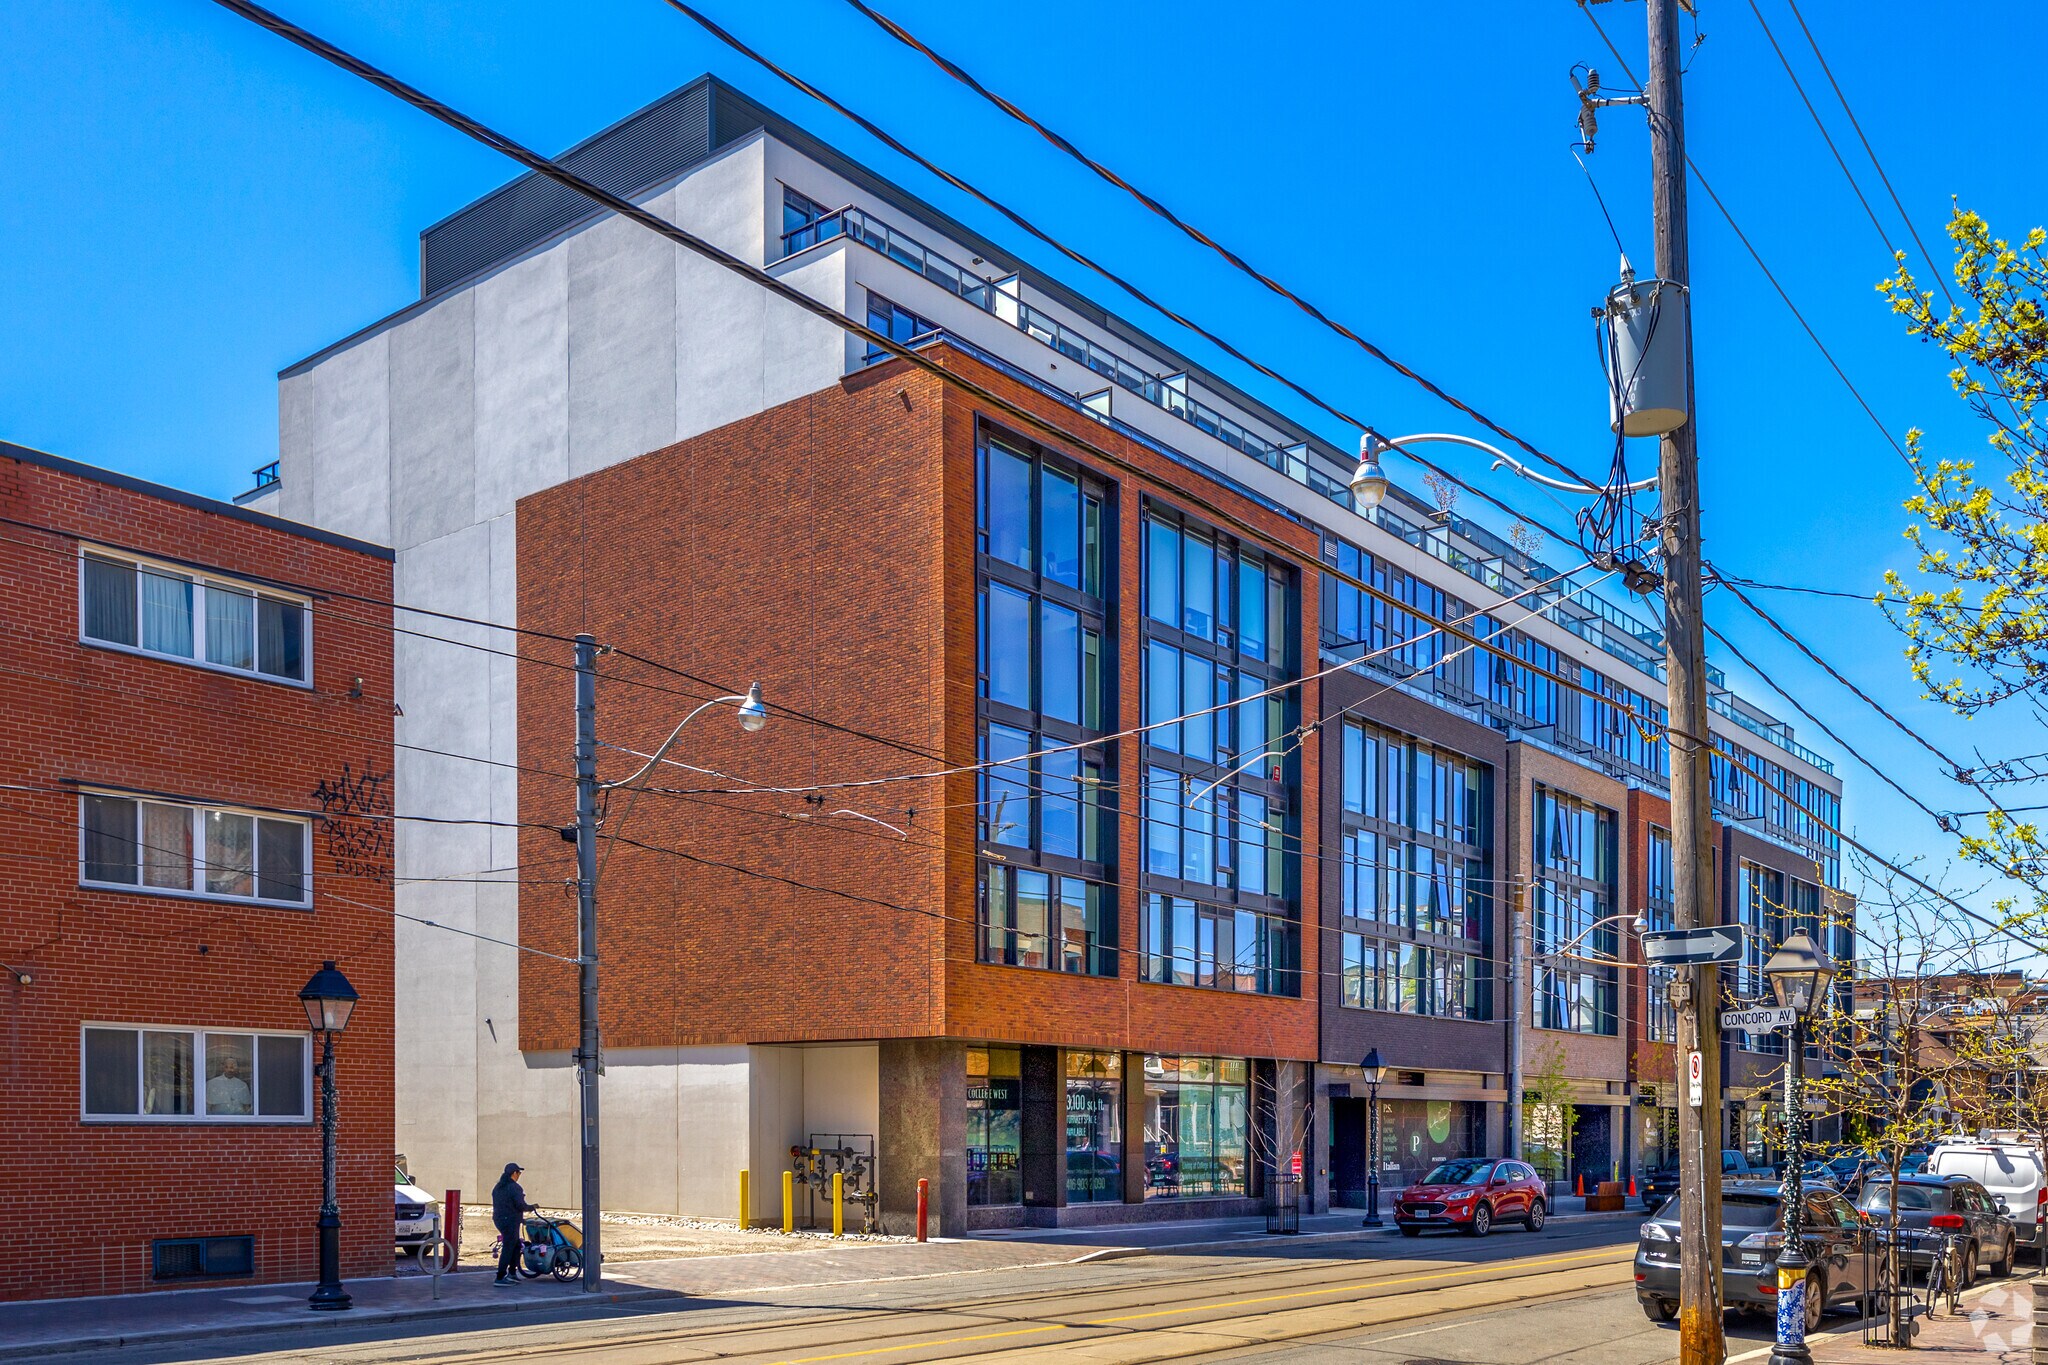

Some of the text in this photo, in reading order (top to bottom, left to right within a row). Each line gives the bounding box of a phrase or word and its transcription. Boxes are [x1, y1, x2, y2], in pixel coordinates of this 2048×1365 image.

[1724, 1009, 1792, 1026] CONCORD AV.
[967, 1088, 1008, 1100] COLLEGE WEST
[1412, 1135, 1420, 1152] P
